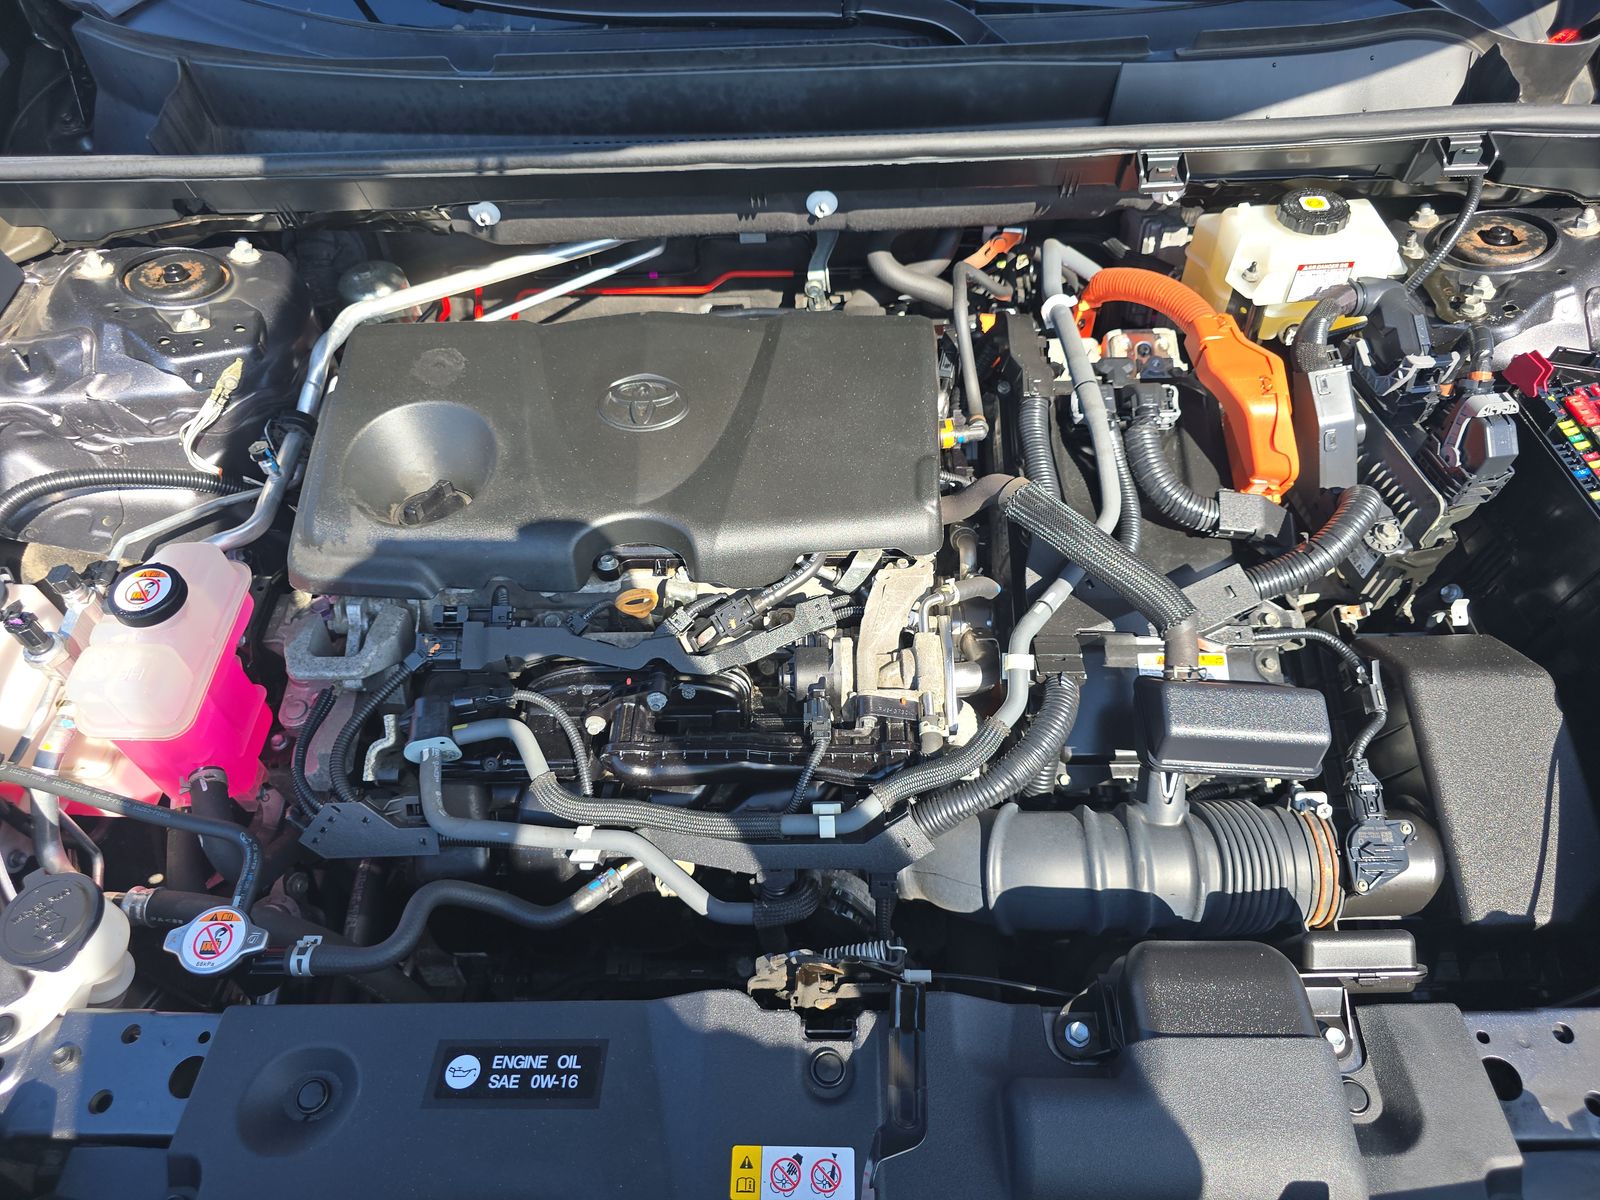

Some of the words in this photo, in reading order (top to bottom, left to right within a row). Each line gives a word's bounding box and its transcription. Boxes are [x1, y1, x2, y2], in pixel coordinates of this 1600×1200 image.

[492, 1055, 548, 1069] ENGINE
[557, 1054, 581, 1069] OIL
[488, 1074, 520, 1089] SAE
[530, 1074, 578, 1089] 0W-16
